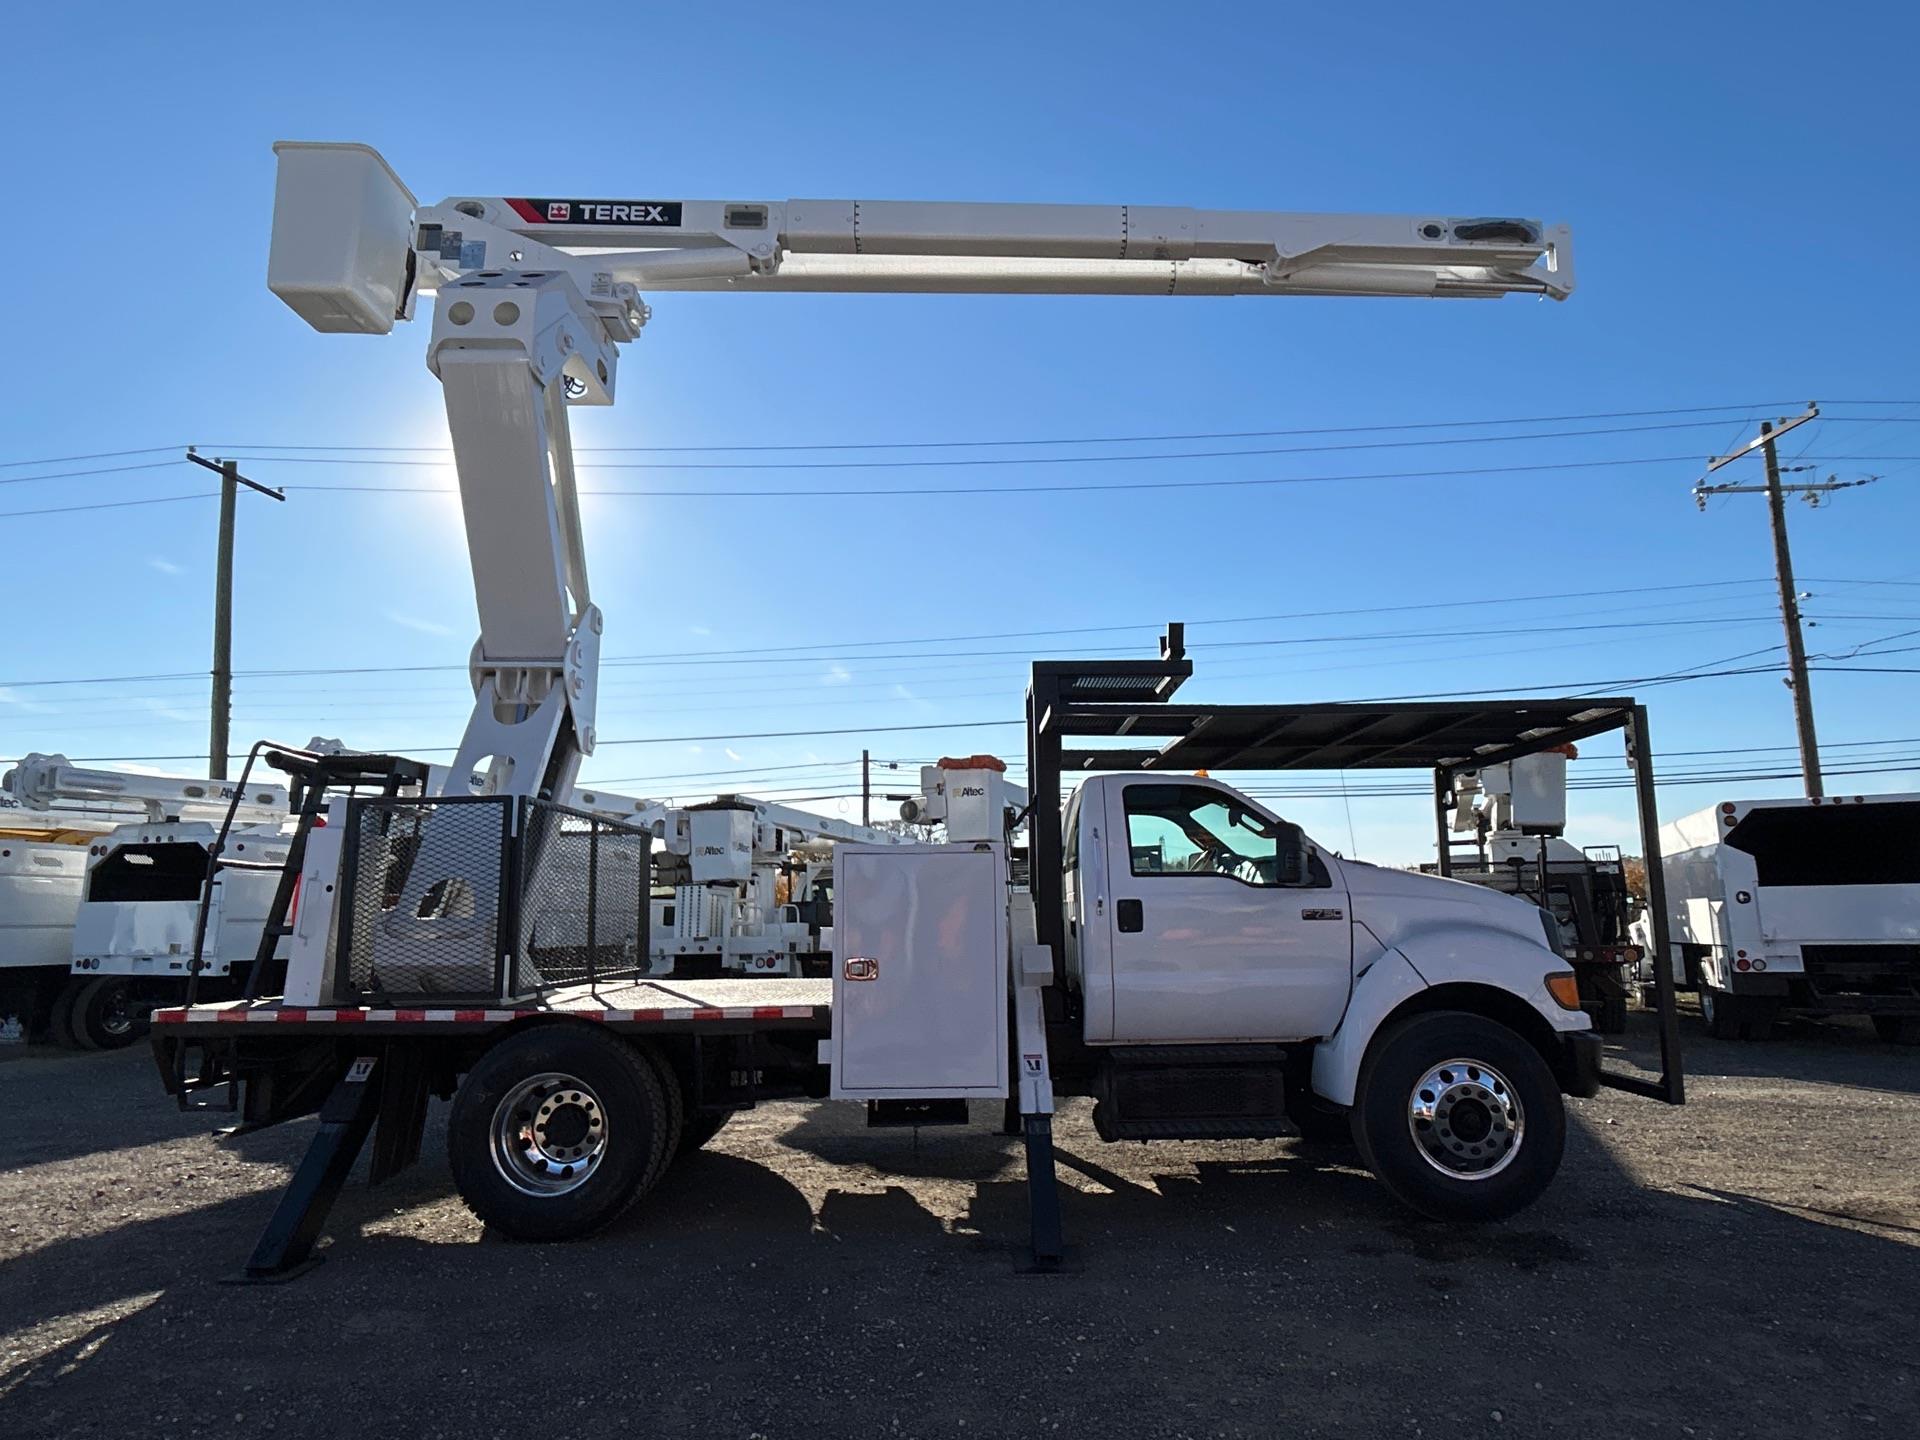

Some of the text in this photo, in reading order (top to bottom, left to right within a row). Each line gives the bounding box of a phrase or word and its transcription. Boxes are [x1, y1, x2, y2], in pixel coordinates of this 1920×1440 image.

[579, 204, 664, 222] TEREX
[219, 787, 246, 800] Altc
[962, 786, 984, 797] Altec
[704, 846, 725, 856] Altec
